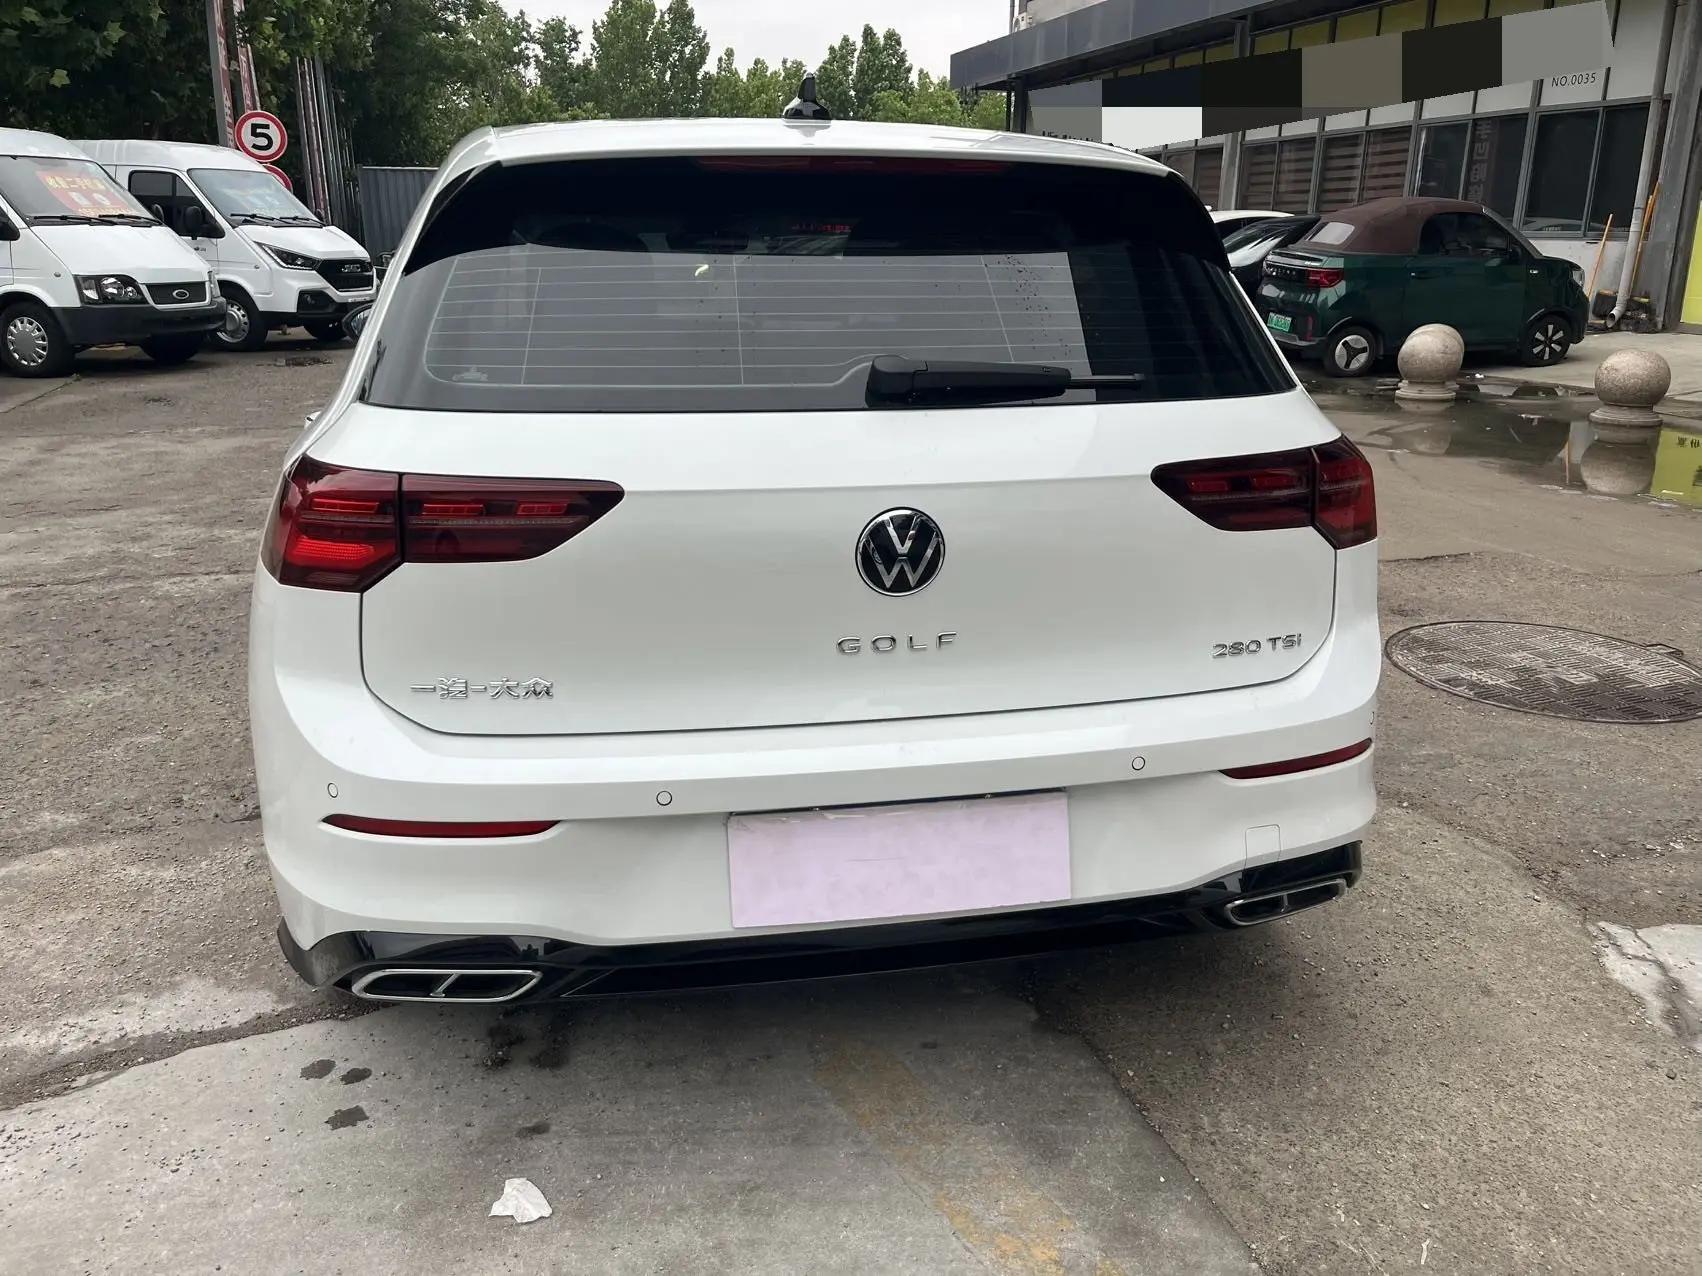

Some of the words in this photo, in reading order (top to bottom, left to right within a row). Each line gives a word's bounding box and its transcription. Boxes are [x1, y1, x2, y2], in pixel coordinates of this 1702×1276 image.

[1551, 72, 1597, 88] NO.0035
[250, 122, 274, 151] 5
[836, 631, 957, 654] GOLF
[1212, 640, 1262, 658] 280
